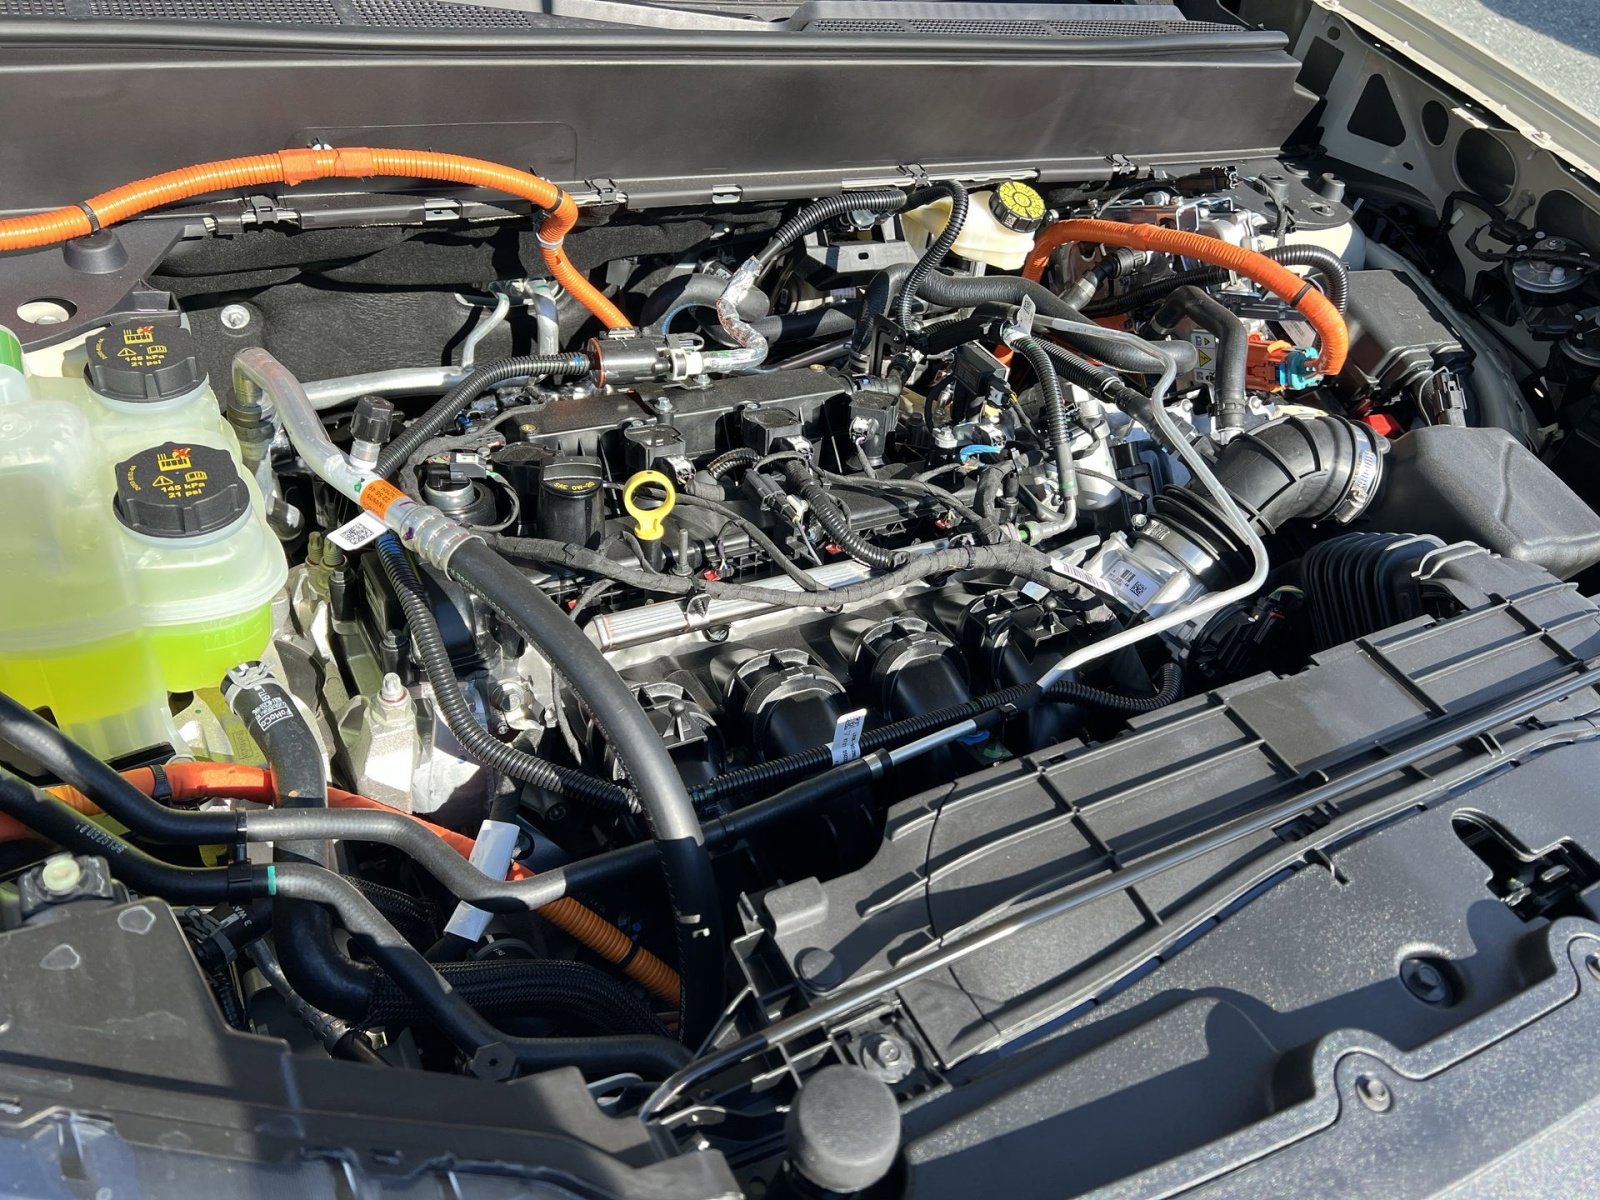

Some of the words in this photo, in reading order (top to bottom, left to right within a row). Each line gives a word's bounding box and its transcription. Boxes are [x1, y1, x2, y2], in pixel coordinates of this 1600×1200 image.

[161, 484, 181, 493] 145
[553, 482, 569, 490] SAE
[571, 481, 596, 490] 0W-20
[168, 491, 182, 499] 21
[185, 488, 202, 497] psi
[260, 708, 292, 728] FoMoCo
